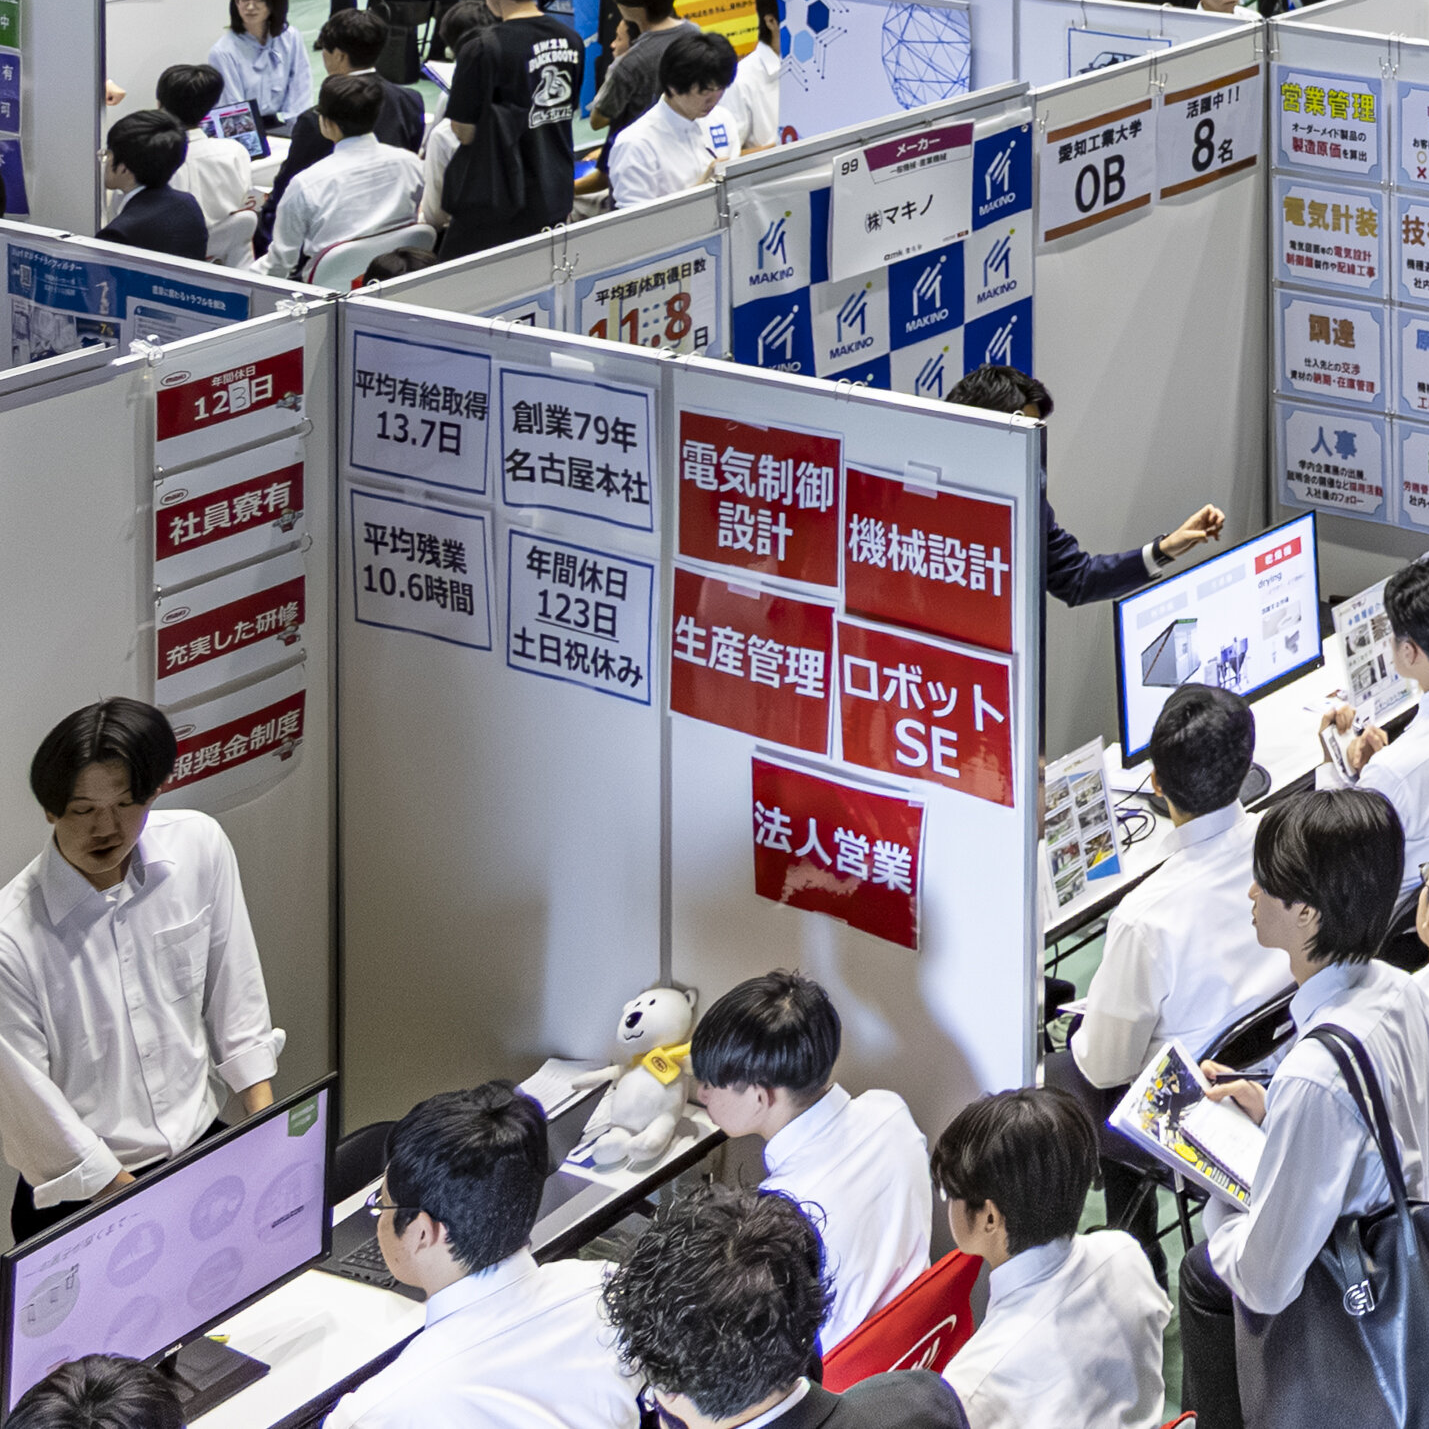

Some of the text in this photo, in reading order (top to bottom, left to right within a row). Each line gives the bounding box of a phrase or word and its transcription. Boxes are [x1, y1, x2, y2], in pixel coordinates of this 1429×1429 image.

[1281, 83, 1376, 123] 営業管理
[841, 158, 858, 177] 99
[897, 136, 940, 159] メーカー
[1057, 120, 1143, 165] 愛知工業大学
[1192, 118, 1235, 174] 8名
[979, 191, 1016, 215] MAKINO
[1075, 154, 1126, 215] OB
[1283, 196, 1379, 238] 電気計装
[749, 266, 794, 287] MAKINO
[976, 280, 1017, 304] MAKINO
[905, 307, 948, 332] MAKINO
[1308, 315, 1355, 351] 調達
[829, 337, 873, 361] MAKINO
[211, 366, 256, 388] 年間休日
[355, 370, 489, 420] 平均有給取得
[375, 413, 462, 455] 13.7日
[512, 401, 638, 453] 創業79年
[1310, 426, 1357, 461] 人事
[505, 449, 650, 505] 名古屋本社
[682, 441, 834, 511] 電気制御
[170, 482, 292, 545] 社員寮有
[718, 500, 794, 561] 設計
[362, 522, 467, 574] 平均残業
[849, 516, 1010, 595] 機械設計
[362, 567, 475, 616] 10.6時間
[526, 547, 628, 600] 年間休日
[166, 603, 299, 666] 充実した研修
[536, 591, 619, 638] 123日
[512, 626, 643, 688] 土日祝休み
[674, 616, 826, 700] 生産管理
[843, 655, 1007, 724] ロボット
[894, 725, 960, 778] SE
[752, 800, 914, 895] 法人営業
